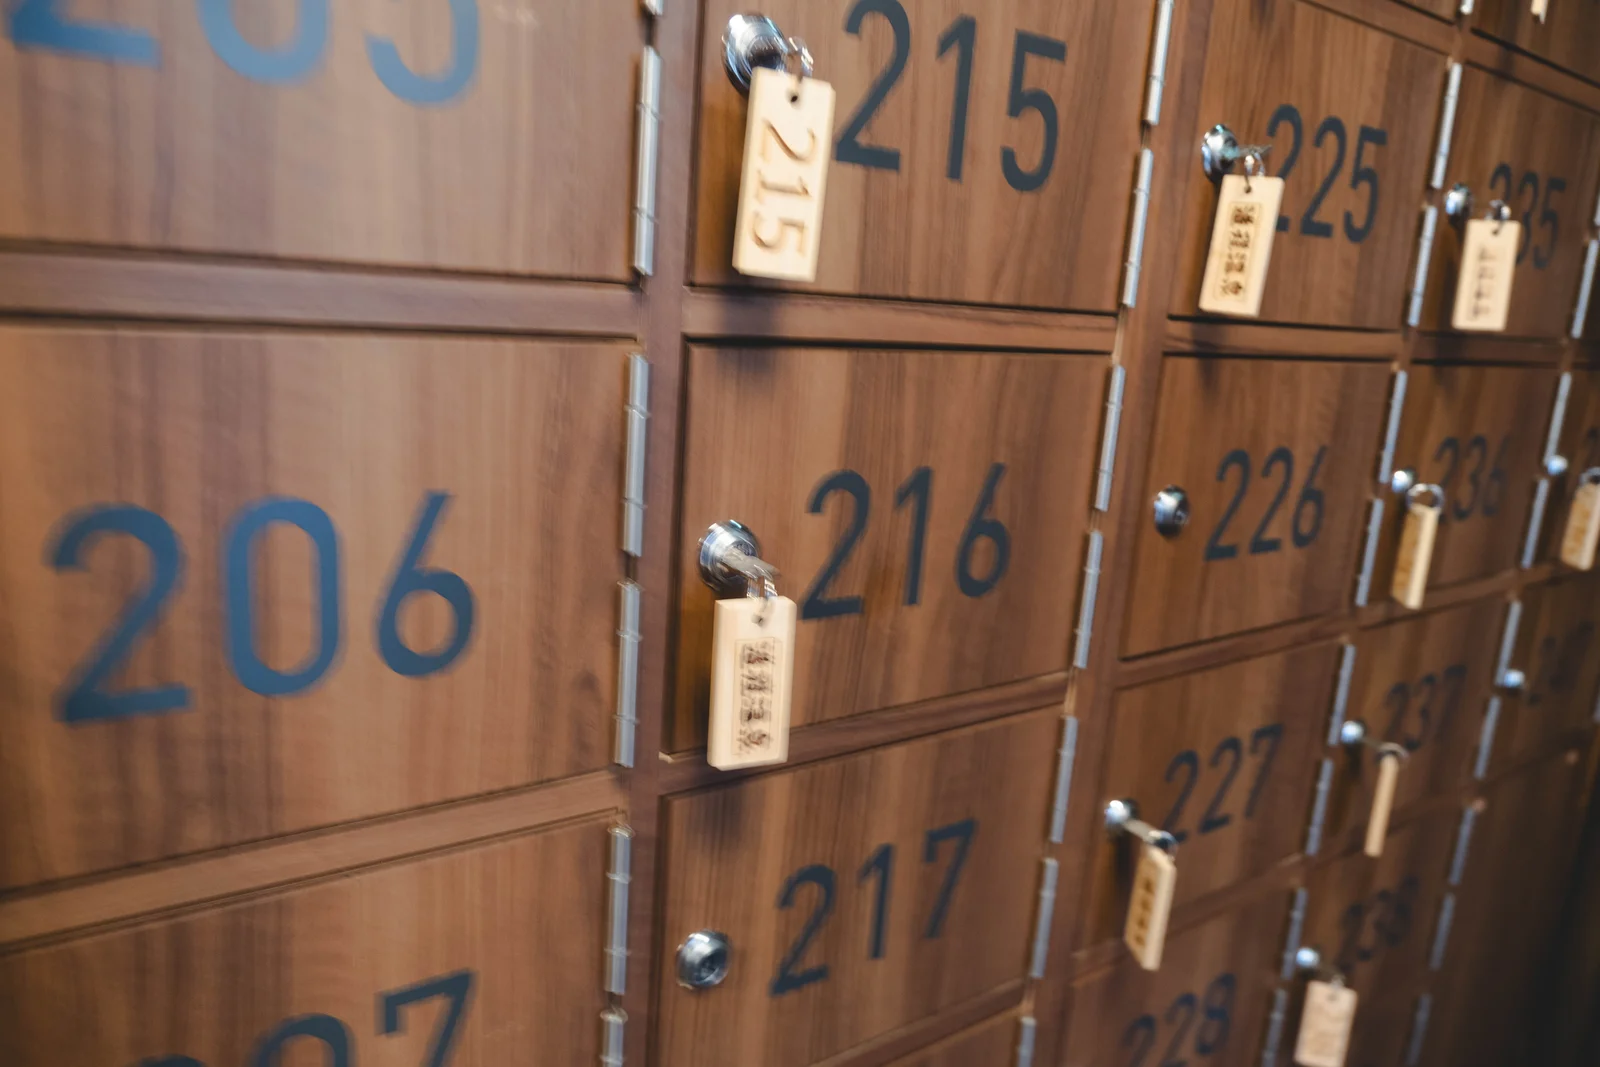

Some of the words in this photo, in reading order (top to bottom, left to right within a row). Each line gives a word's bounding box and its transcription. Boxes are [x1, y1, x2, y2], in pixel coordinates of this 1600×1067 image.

[833, 0, 1067, 192] 215
[751, 116, 818, 260] 215
[1266, 105, 1388, 244] 225
[801, 462, 1011, 621] 216
[1206, 446, 1326, 562] 226
[48, 489, 477, 724] 206
[1162, 724, 1284, 844] 227
[769, 818, 977, 998] 217
